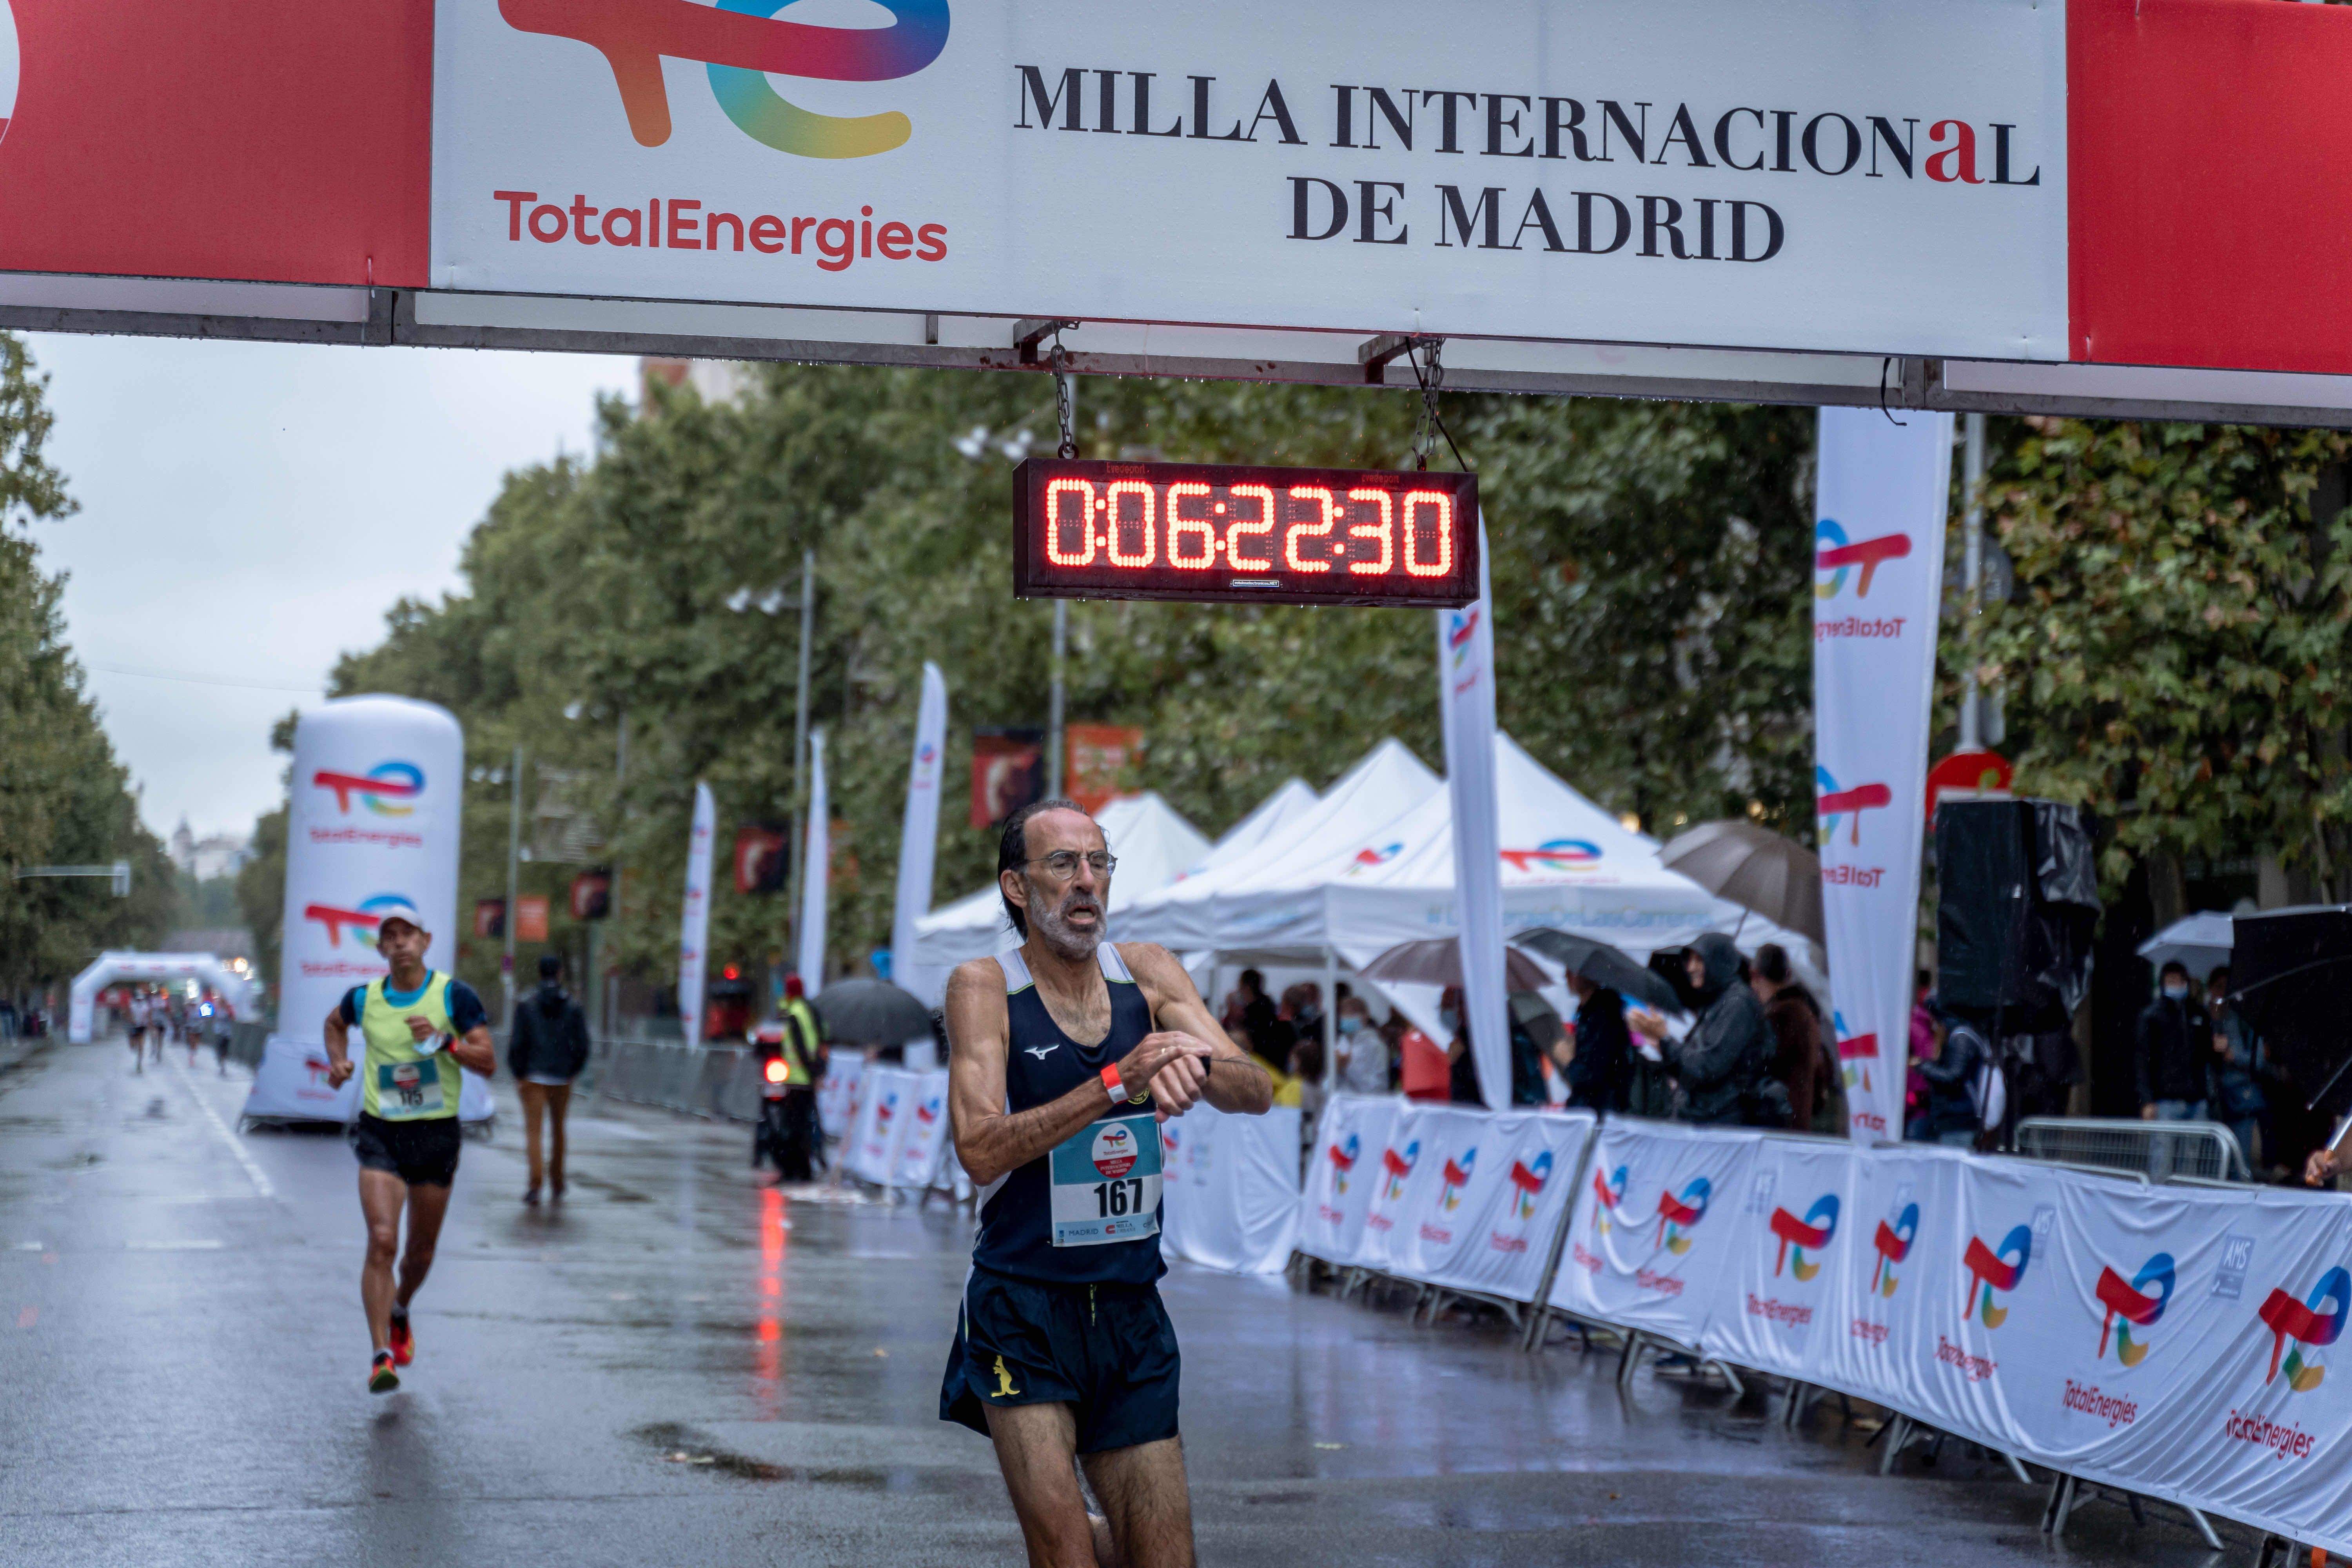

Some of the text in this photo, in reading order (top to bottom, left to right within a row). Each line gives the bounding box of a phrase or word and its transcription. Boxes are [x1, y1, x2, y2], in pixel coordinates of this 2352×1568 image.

[1014, 65, 1308, 145] MILLA
[494, 191, 947, 271] TotalEnergies
[1286, 176, 1784, 262] DE MADRID
[1094, 1178, 1143, 1218] 167
[1069, 1228, 1098, 1236] MADRID
[2223, 1240, 2251, 1270] AMS
[2062, 1379, 2138, 1427] TotalEnergies
